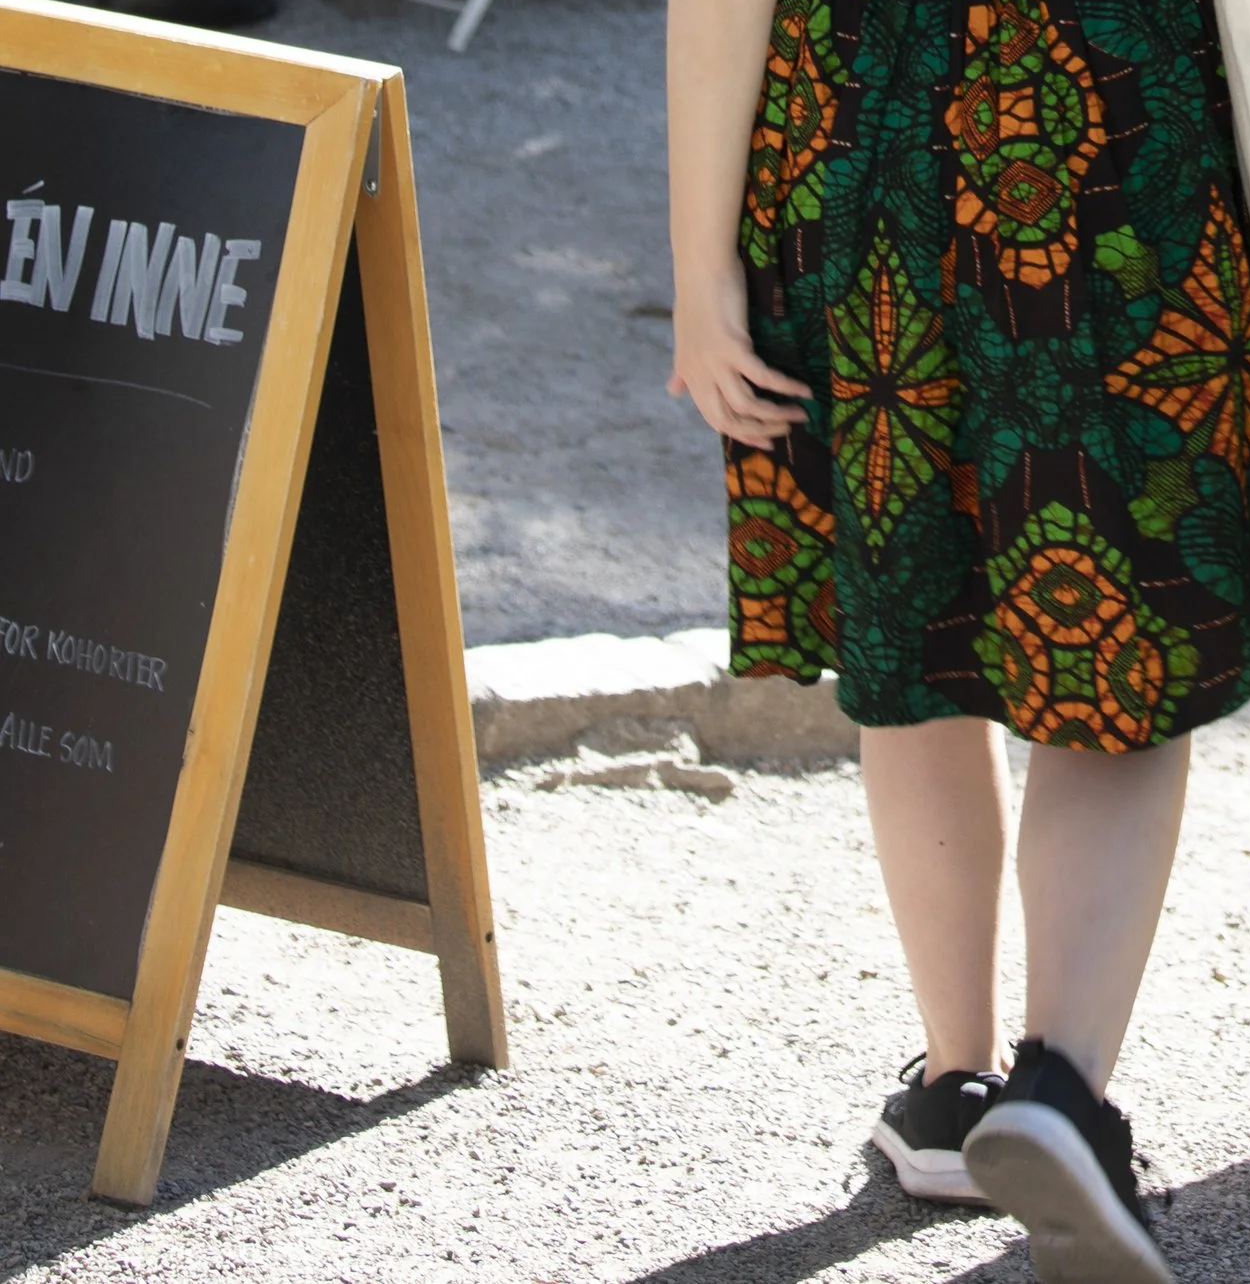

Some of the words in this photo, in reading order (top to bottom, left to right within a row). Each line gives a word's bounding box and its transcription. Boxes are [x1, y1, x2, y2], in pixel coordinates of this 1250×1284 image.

[90, 219, 262, 346] INNE
[47, 629, 168, 692] KOHORTER
[0, 712, 53, 757] ALLE
